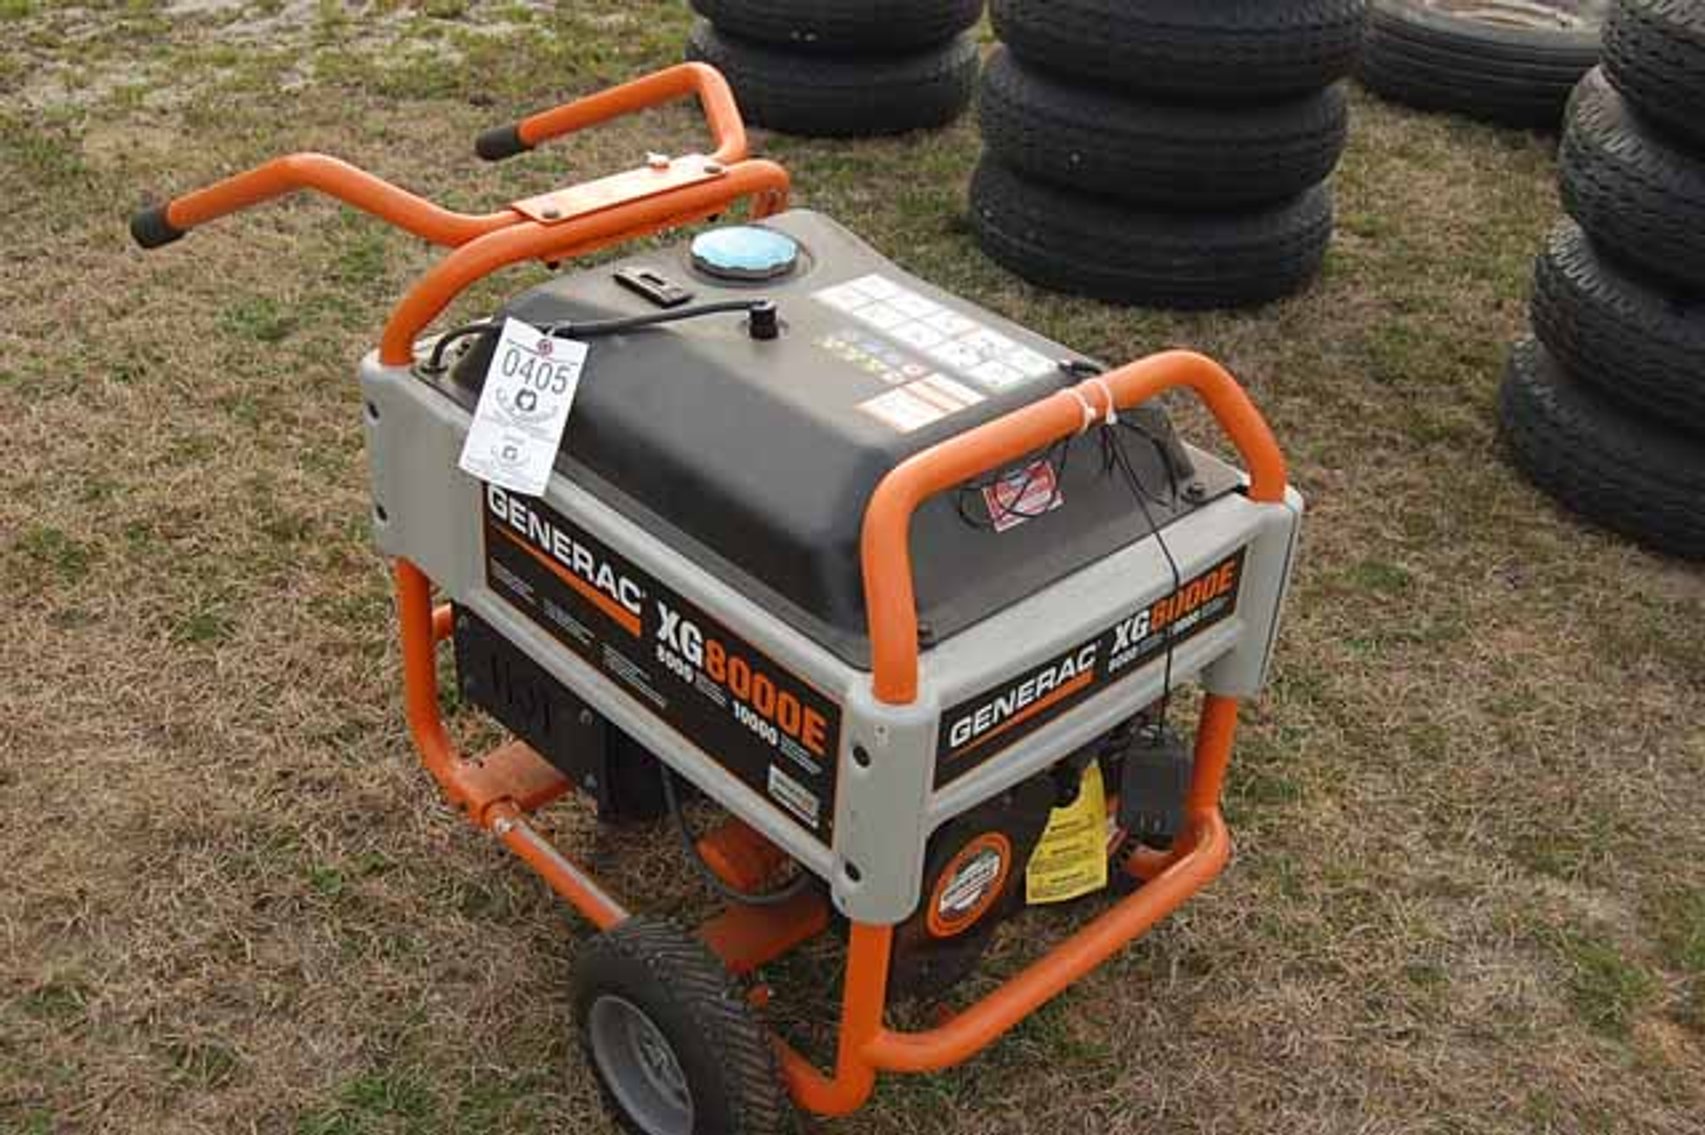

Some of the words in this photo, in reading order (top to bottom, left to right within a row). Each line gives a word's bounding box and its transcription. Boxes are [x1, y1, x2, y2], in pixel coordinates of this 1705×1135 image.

[502, 348, 571, 396] 0405
[486, 484, 643, 615] GENERAC
[950, 643, 1097, 748] GENERAC
